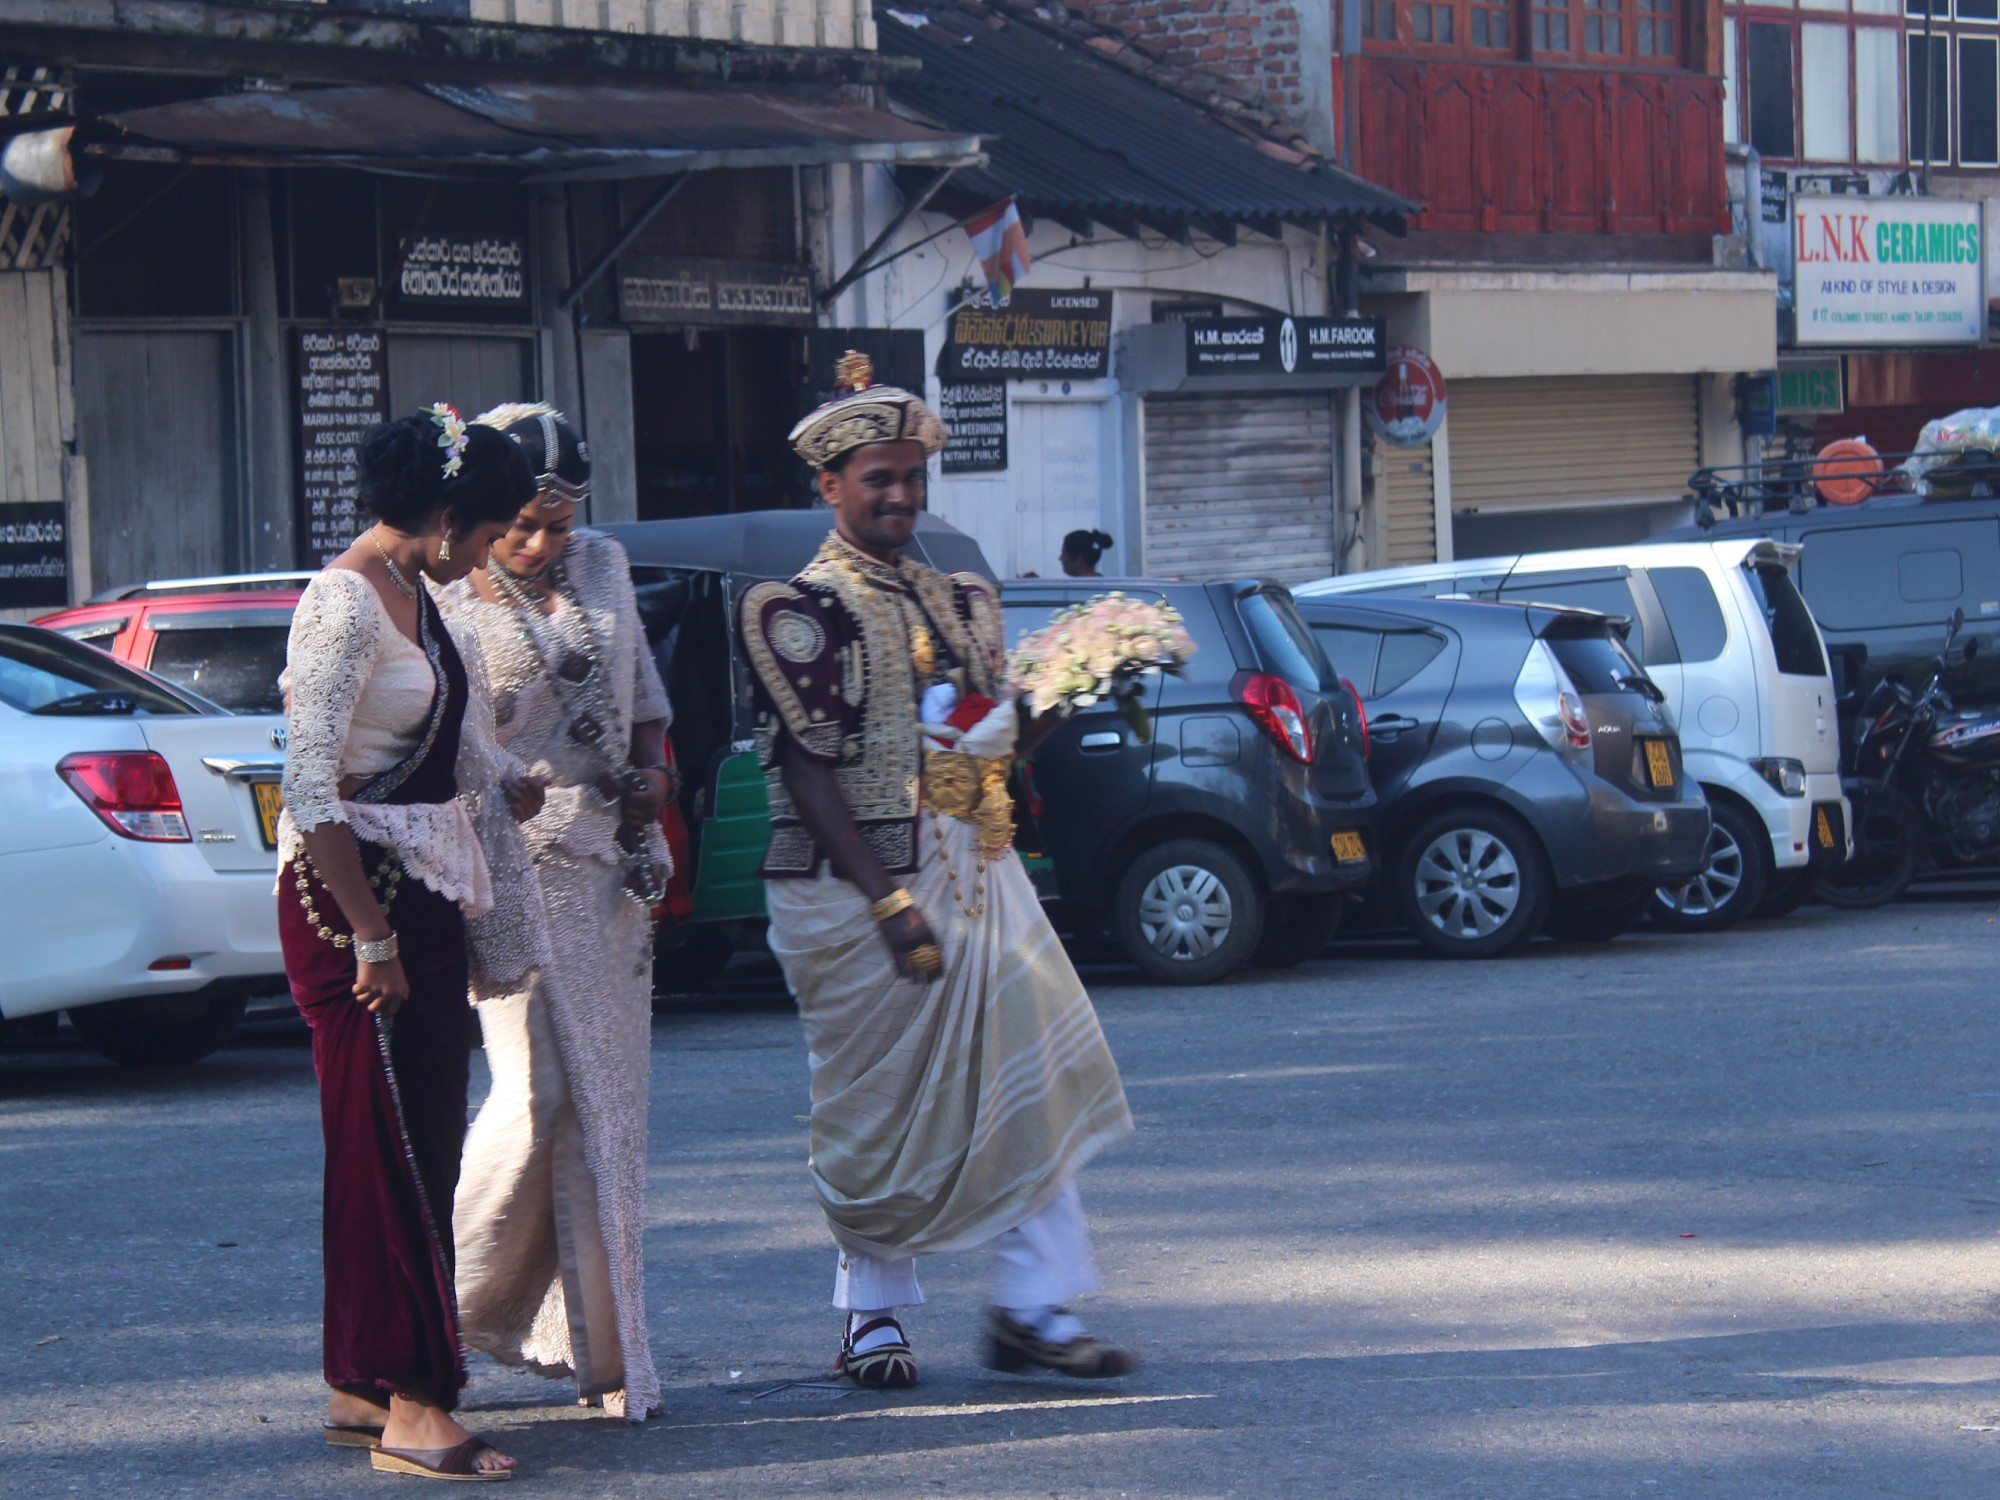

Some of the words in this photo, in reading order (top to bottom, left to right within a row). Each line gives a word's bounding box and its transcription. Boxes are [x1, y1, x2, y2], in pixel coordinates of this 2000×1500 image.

[1796, 213, 1870, 262] L.N.K
[1876, 222, 1978, 264] CERAMICS
[1860, 280, 1874, 295] OF
[1877, 281, 1908, 295] STYLE
[1912, 281, 1919, 295] &
[1922, 281, 1956, 295] DESIGN
[1050, 297, 1099, 308] LICENSED
[1033, 320, 1108, 347] SURVEYOR
[1309, 327, 1376, 345] H.M.FAROOK
[973, 448, 1001, 462] PUBLIC
[1597, 725, 1621, 734] AQUA
